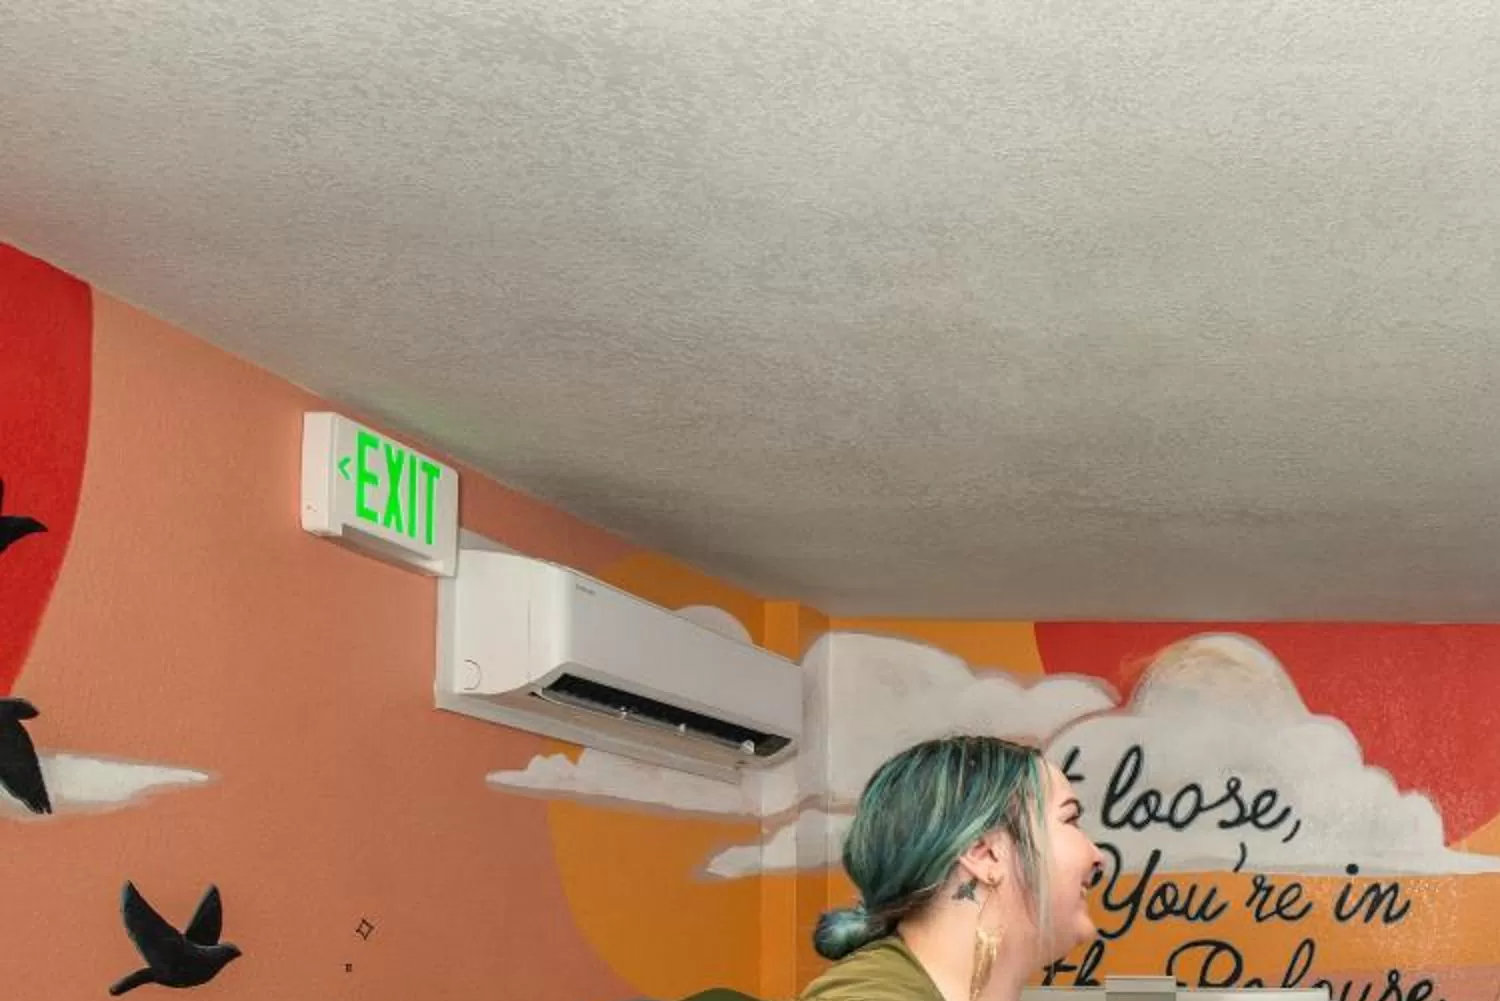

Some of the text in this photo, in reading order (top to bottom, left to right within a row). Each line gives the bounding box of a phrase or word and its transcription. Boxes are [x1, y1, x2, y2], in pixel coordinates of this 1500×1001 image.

[356, 431, 441, 545] EXIT
[1101, 744, 1301, 843] loose,
[1091, 842, 1410, 939] You're in
